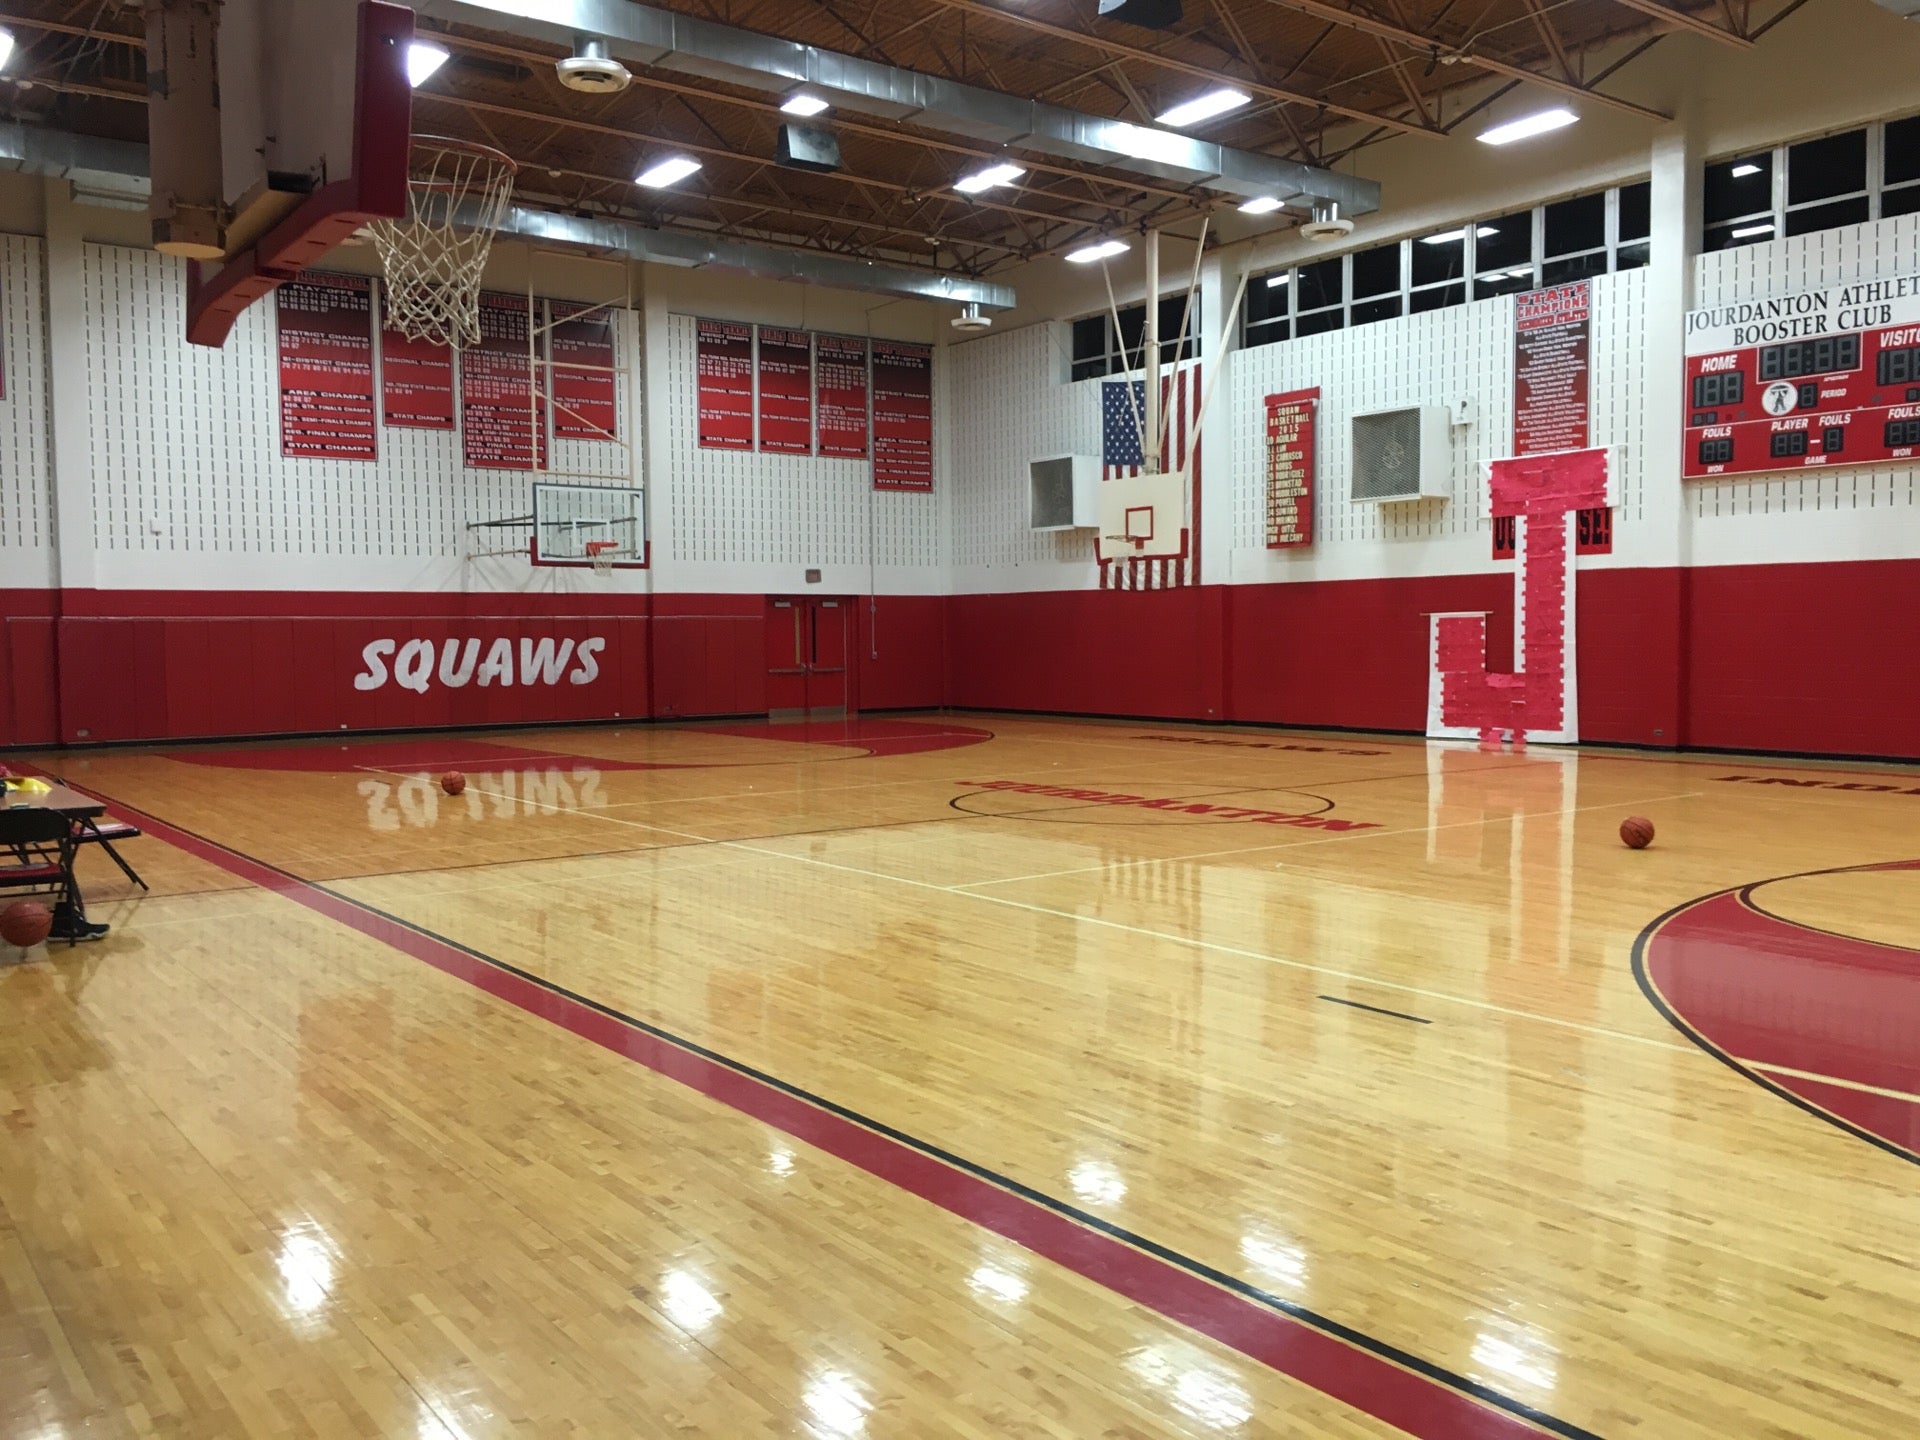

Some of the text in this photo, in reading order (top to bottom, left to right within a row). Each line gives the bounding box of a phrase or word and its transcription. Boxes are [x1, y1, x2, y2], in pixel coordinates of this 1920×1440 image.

[292, 284, 354, 296] PLAY-OFFS
[1517, 283, 1589, 304] STATE
[1518, 294, 1588, 318] CHAMPIONS
[1688, 290, 1829, 335] JOURDANTON
[1733, 304, 1892, 346] BOOSTER CLUB
[281, 329, 368, 342] DISTRICT CHAMPS
[282, 356, 332, 365] BI-DISTRICT
[1701, 354, 1738, 372] HOME
[1821, 388, 1847, 399] PERIOD
[1277, 406, 1300, 416] SQUAW
[1269, 413, 1309, 426] BASKETBALL
[1771, 414, 1851, 430] PLAYER FOULS
[1279, 424, 1299, 434] 2015
[1702, 427, 1731, 438] FOULS
[1893, 448, 1912, 457] WON
[1804, 456, 1826, 464] GAME
[354, 637, 605, 694] SQUAWS
[953, 780, 1384, 831] JOURDANTON
